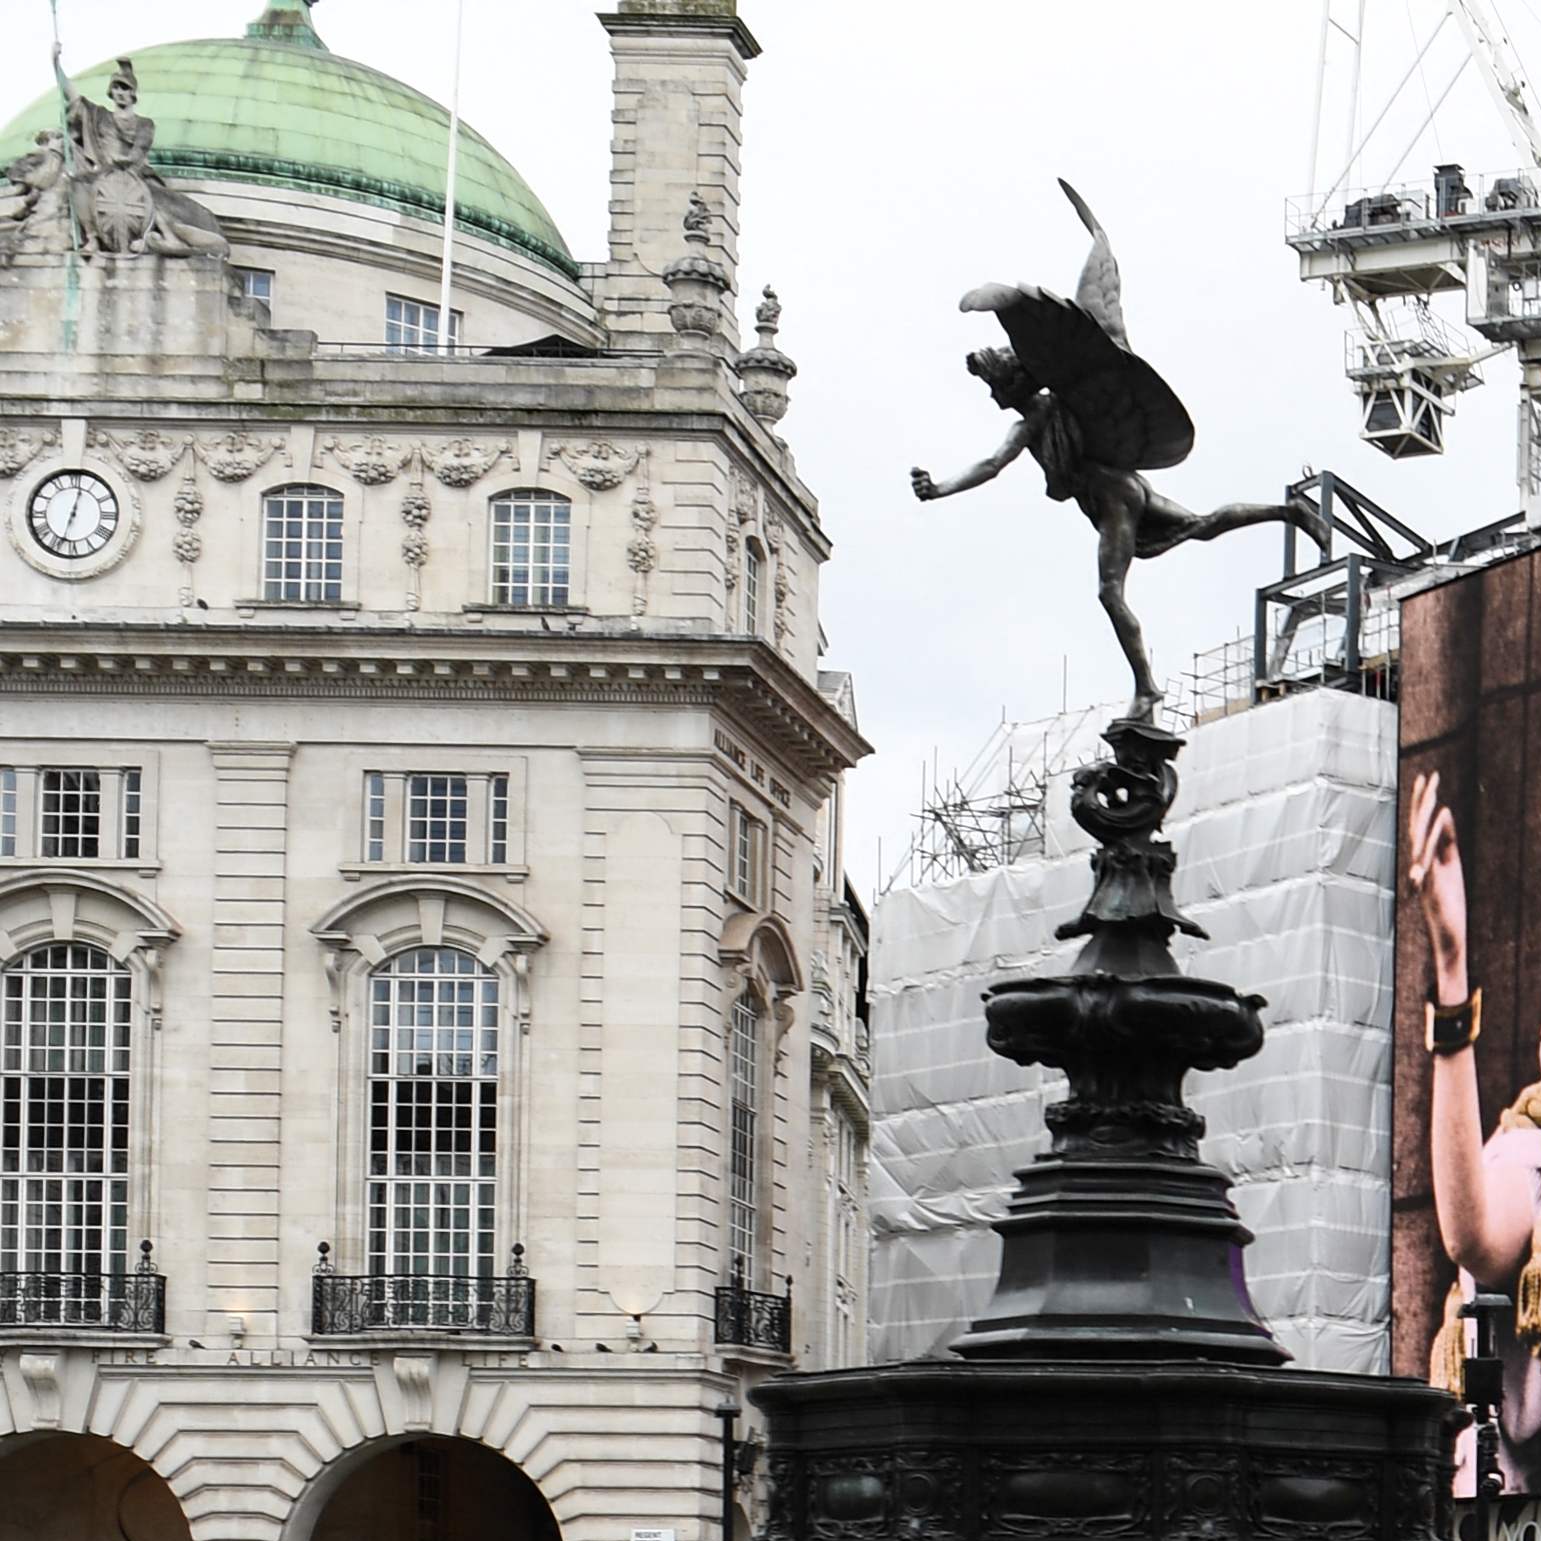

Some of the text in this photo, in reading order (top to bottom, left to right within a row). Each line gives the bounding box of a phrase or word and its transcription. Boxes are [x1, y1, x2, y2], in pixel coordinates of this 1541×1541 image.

[92, 1350, 530, 1367] FIRE ALLIANCE LIFE
